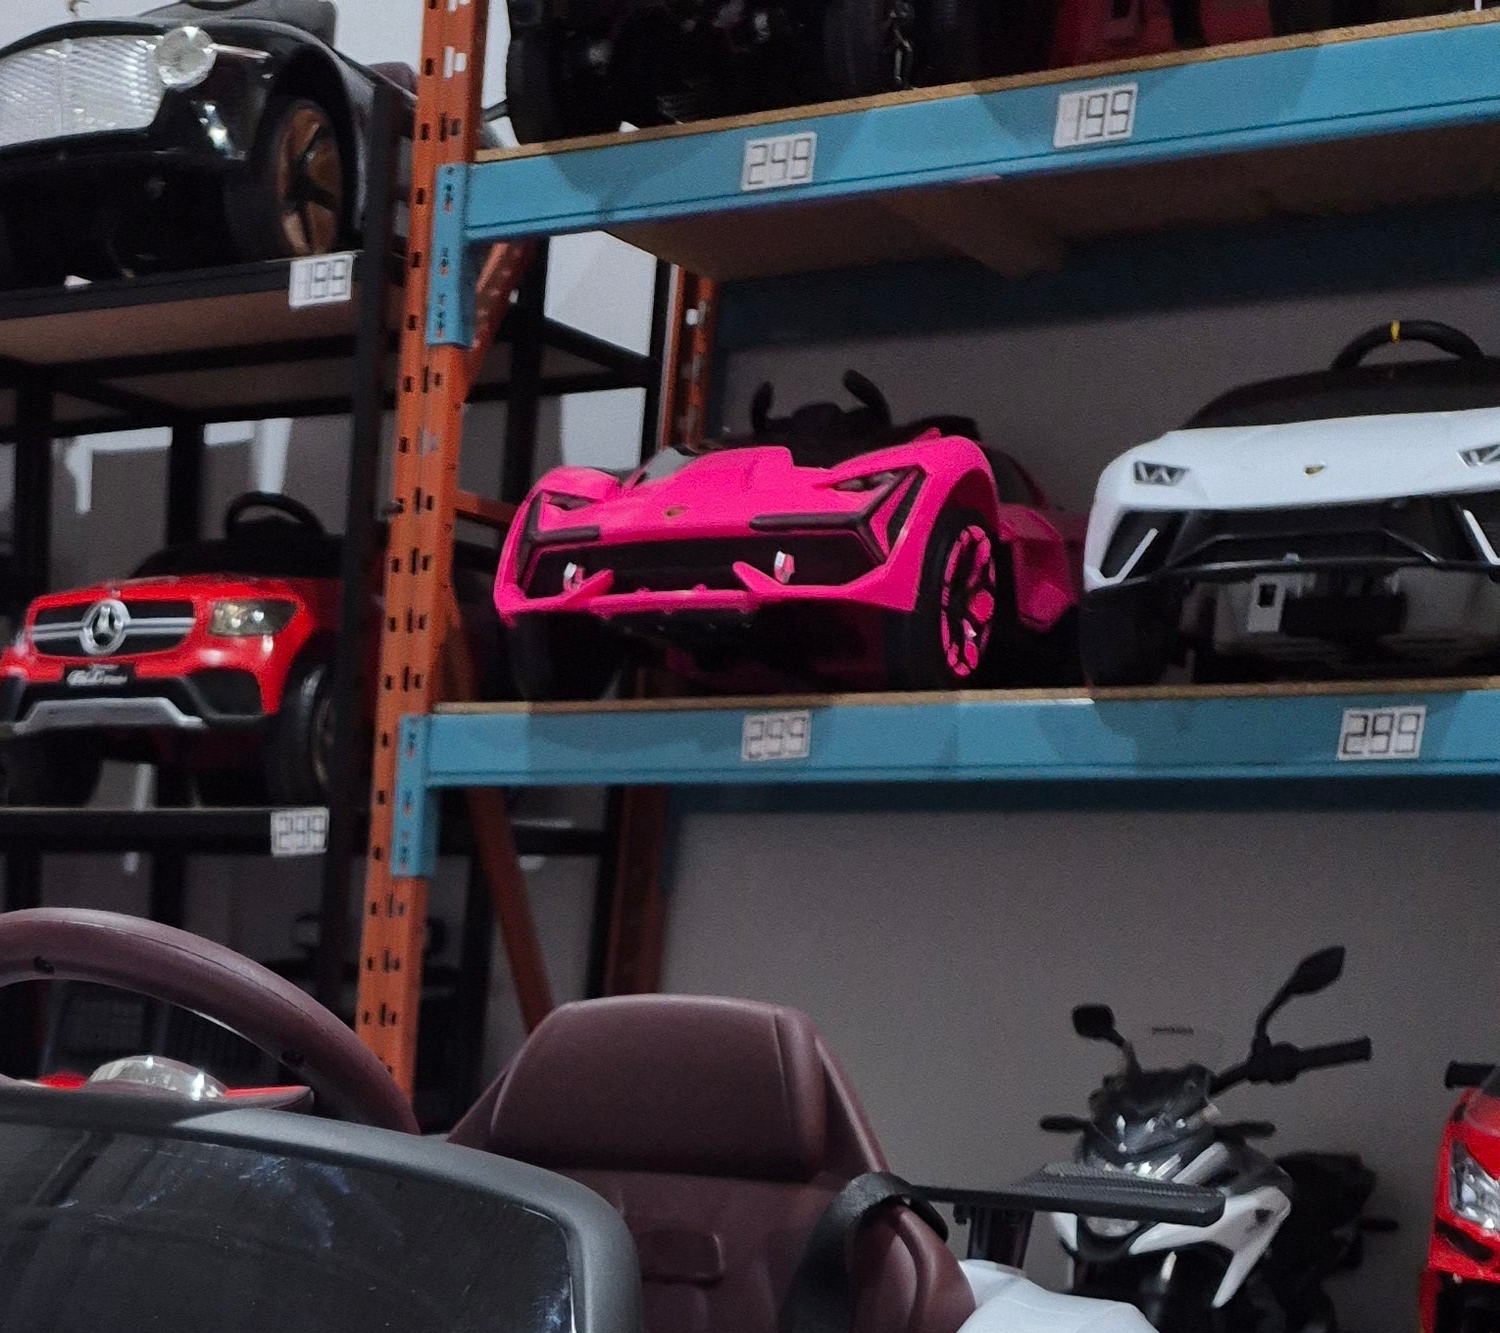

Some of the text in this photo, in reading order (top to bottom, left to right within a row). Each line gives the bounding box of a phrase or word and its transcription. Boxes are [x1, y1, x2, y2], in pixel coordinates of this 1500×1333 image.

[1073, 89, 1133, 141] 199
[747, 137, 812, 185] 249
[308, 259, 348, 299] 199
[744, 716, 808, 759] 299
[1342, 712, 1420, 754] 299
